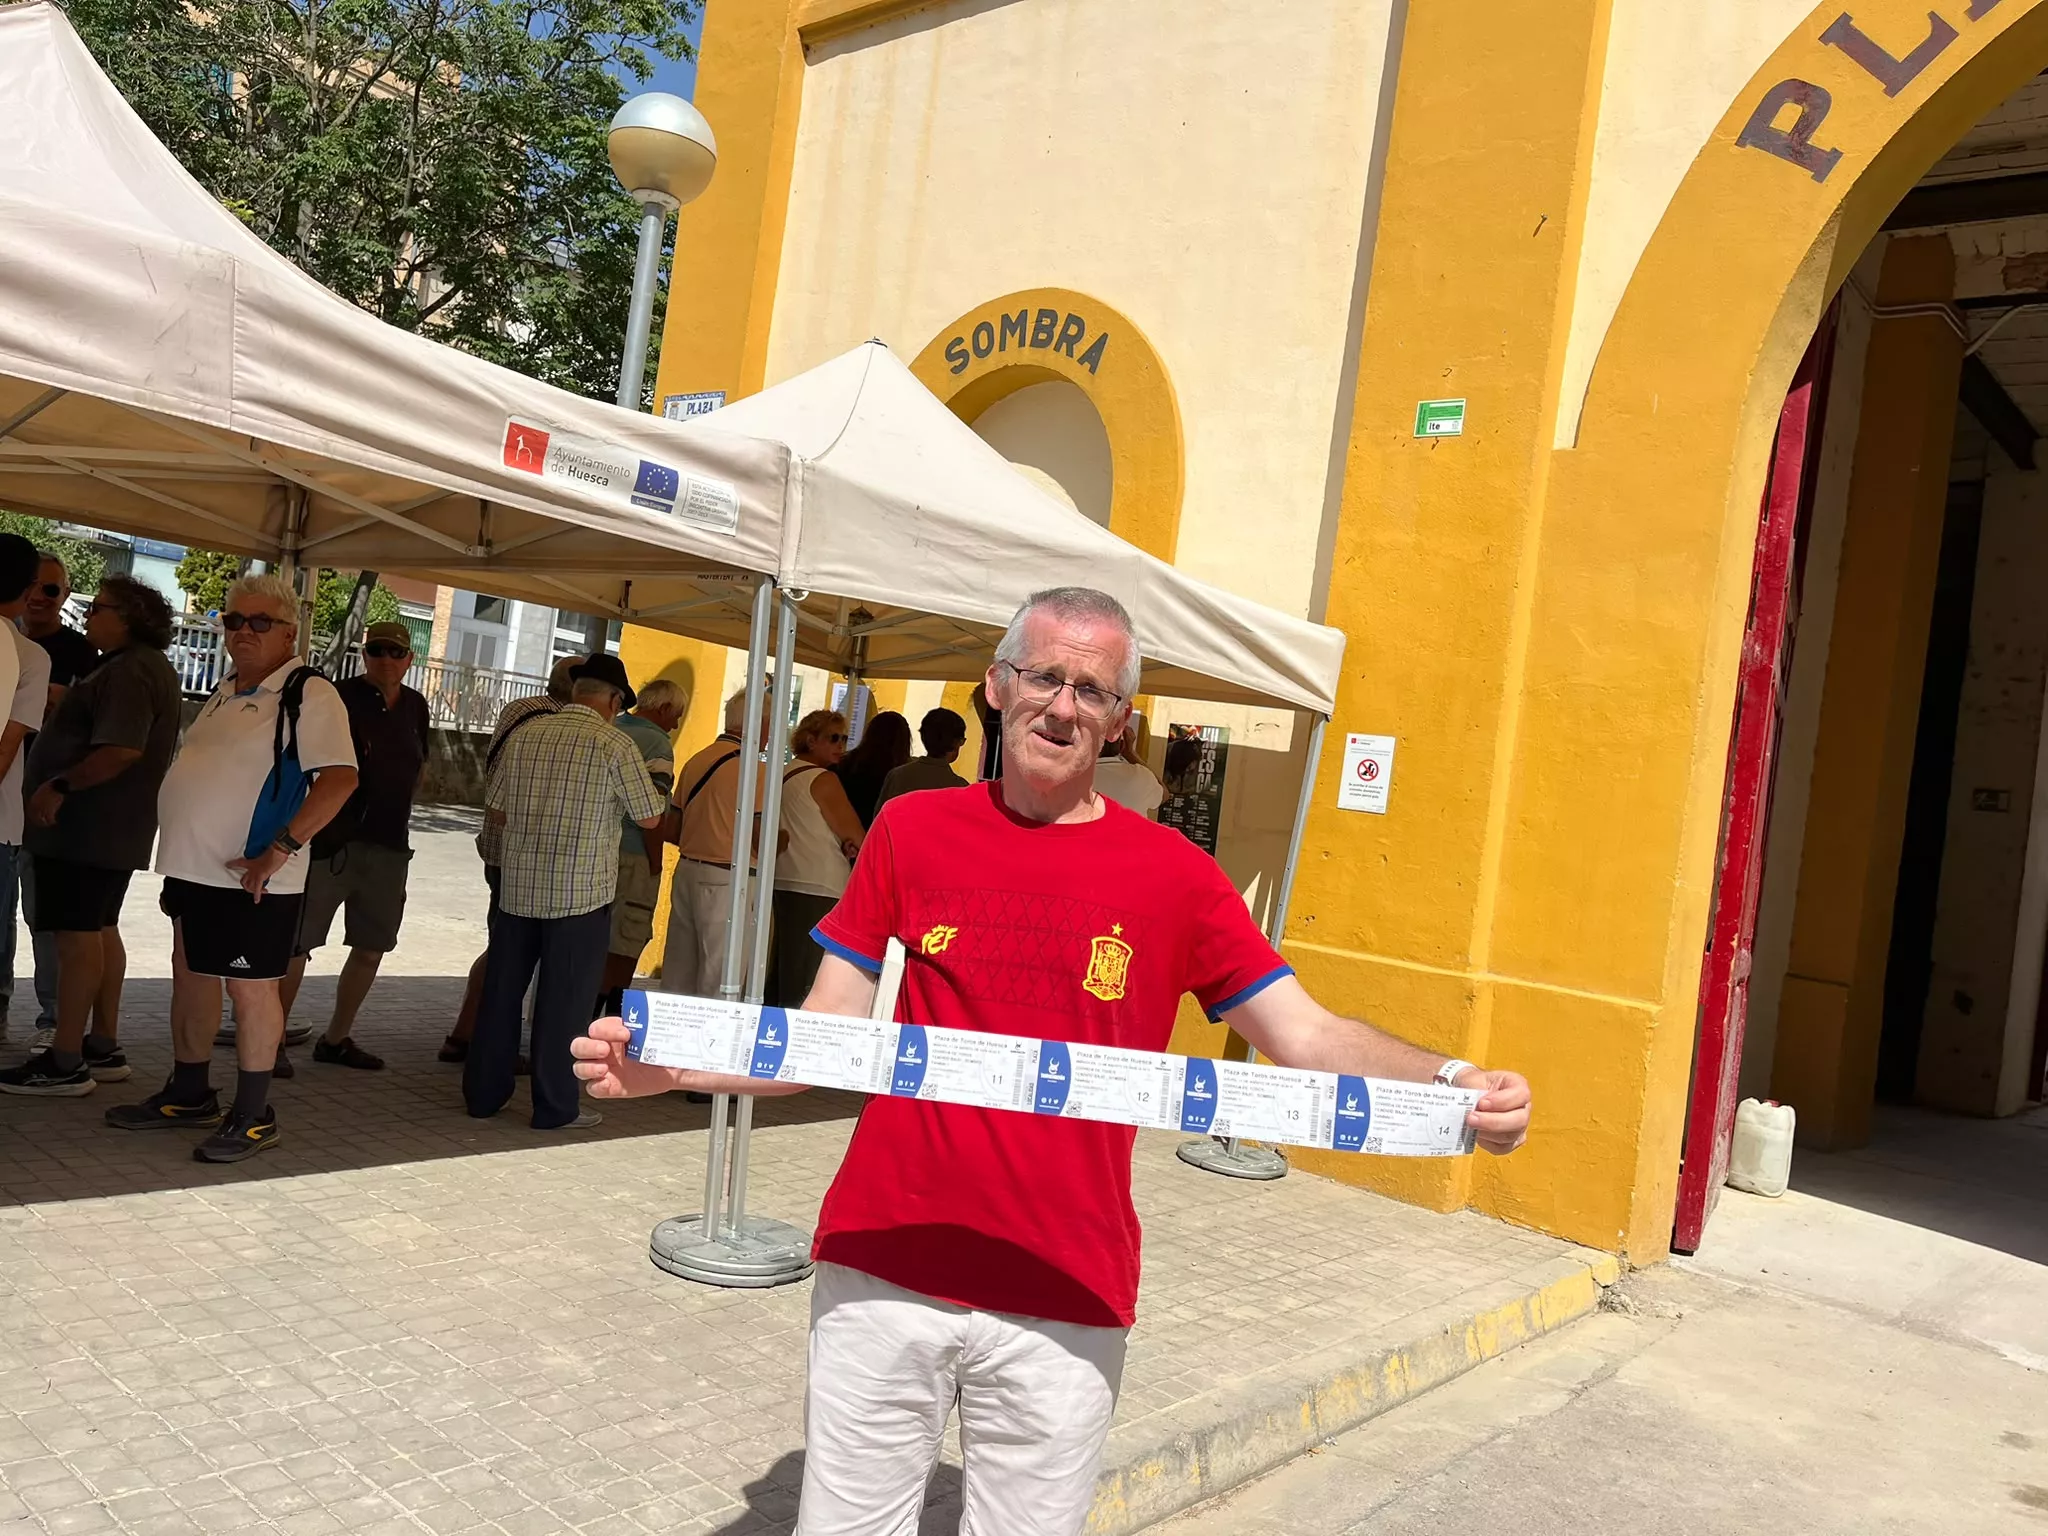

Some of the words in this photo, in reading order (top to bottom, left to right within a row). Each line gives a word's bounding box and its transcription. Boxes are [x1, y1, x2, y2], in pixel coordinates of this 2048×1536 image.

[1735, 0, 2000, 184] PL
[945, 308, 1109, 375] SOMBRA
[686, 401, 713, 415] PLAZA
[554, 447, 630, 477] Ayuntamiento
[551, 462, 564, 473] de
[568, 465, 608, 486] Huesca
[709, 1039, 715, 1048] 7
[851, 1057, 862, 1067] 10
[1224, 1068, 1240, 1076] Plaza
[992, 1074, 1002, 1084] 11
[1376, 1086, 1393, 1094] Plaza
[1138, 1092, 1150, 1102] 12
[1287, 1110, 1299, 1120] 13
[1439, 1126, 1449, 1135] 14
